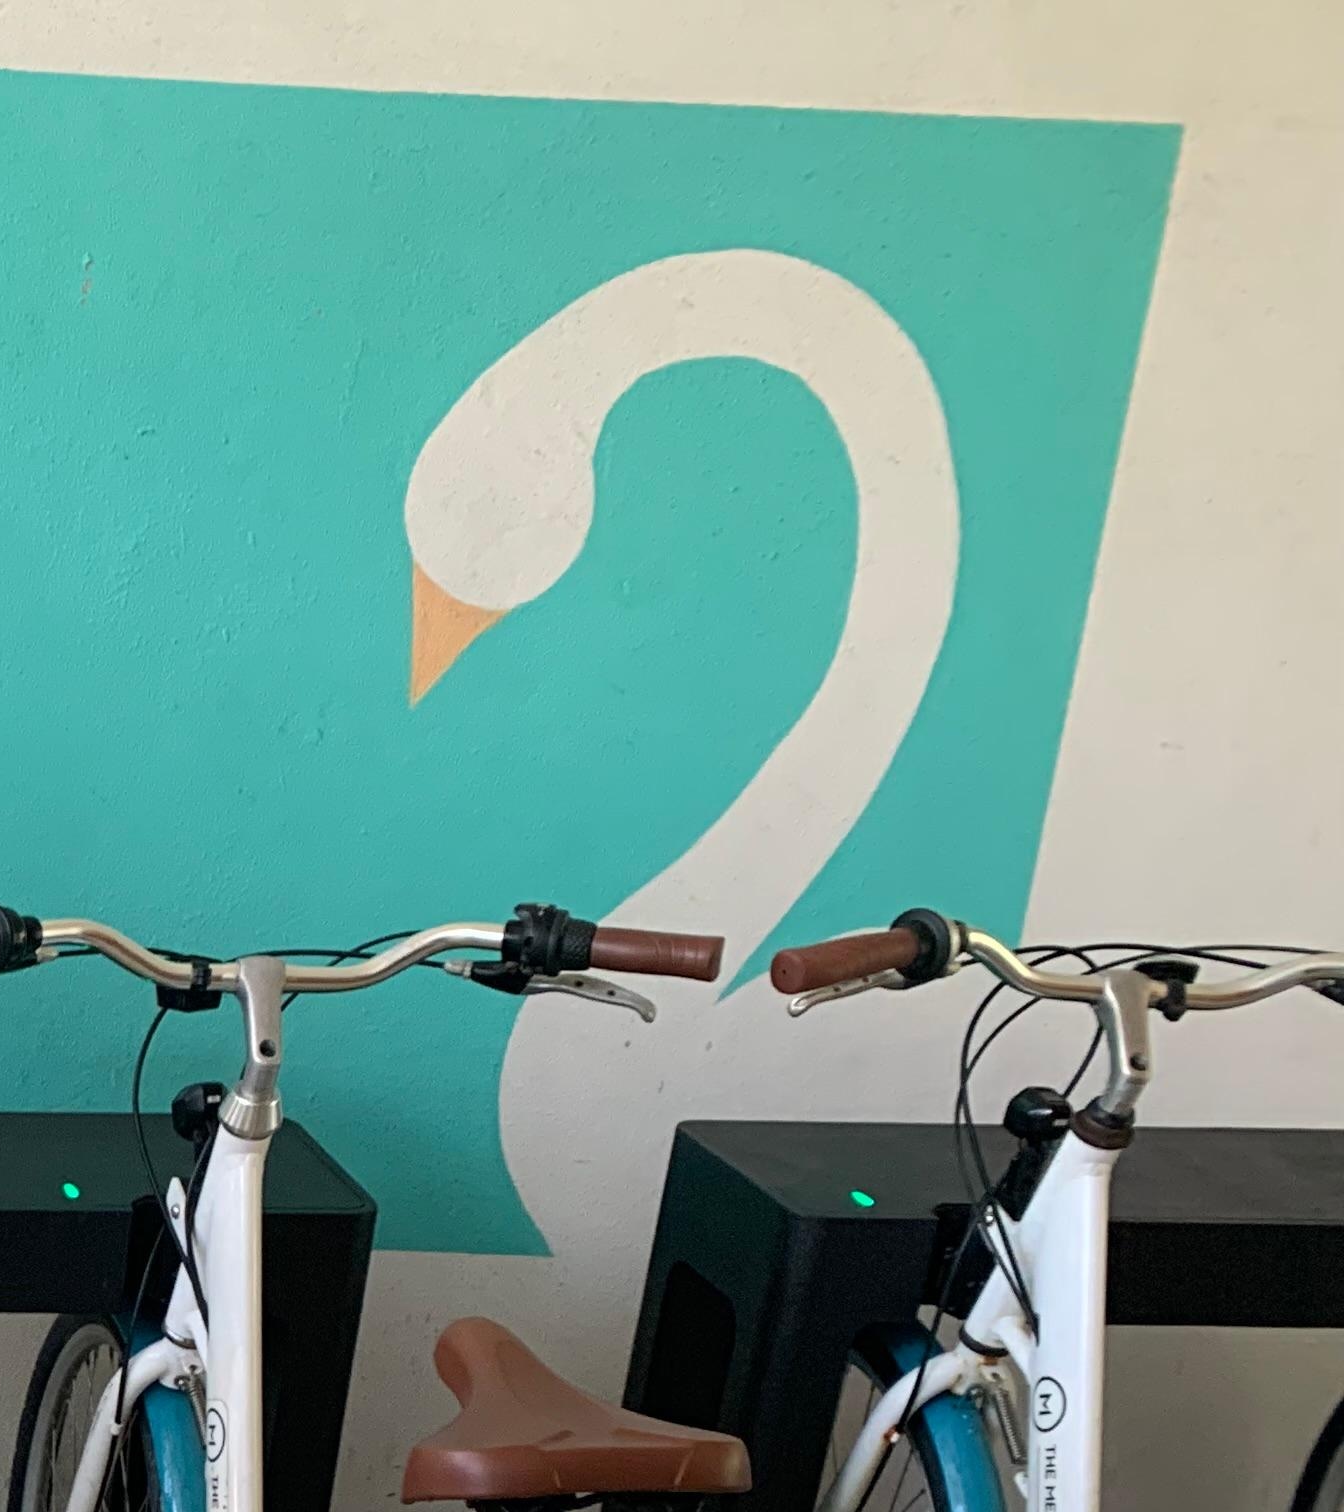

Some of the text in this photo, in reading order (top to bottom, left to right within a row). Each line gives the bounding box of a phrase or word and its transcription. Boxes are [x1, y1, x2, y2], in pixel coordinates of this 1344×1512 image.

[1039, 1391, 1052, 1416] M
[1045, 1445, 1057, 1479] THE
[212, 1475, 220, 1509] THE
